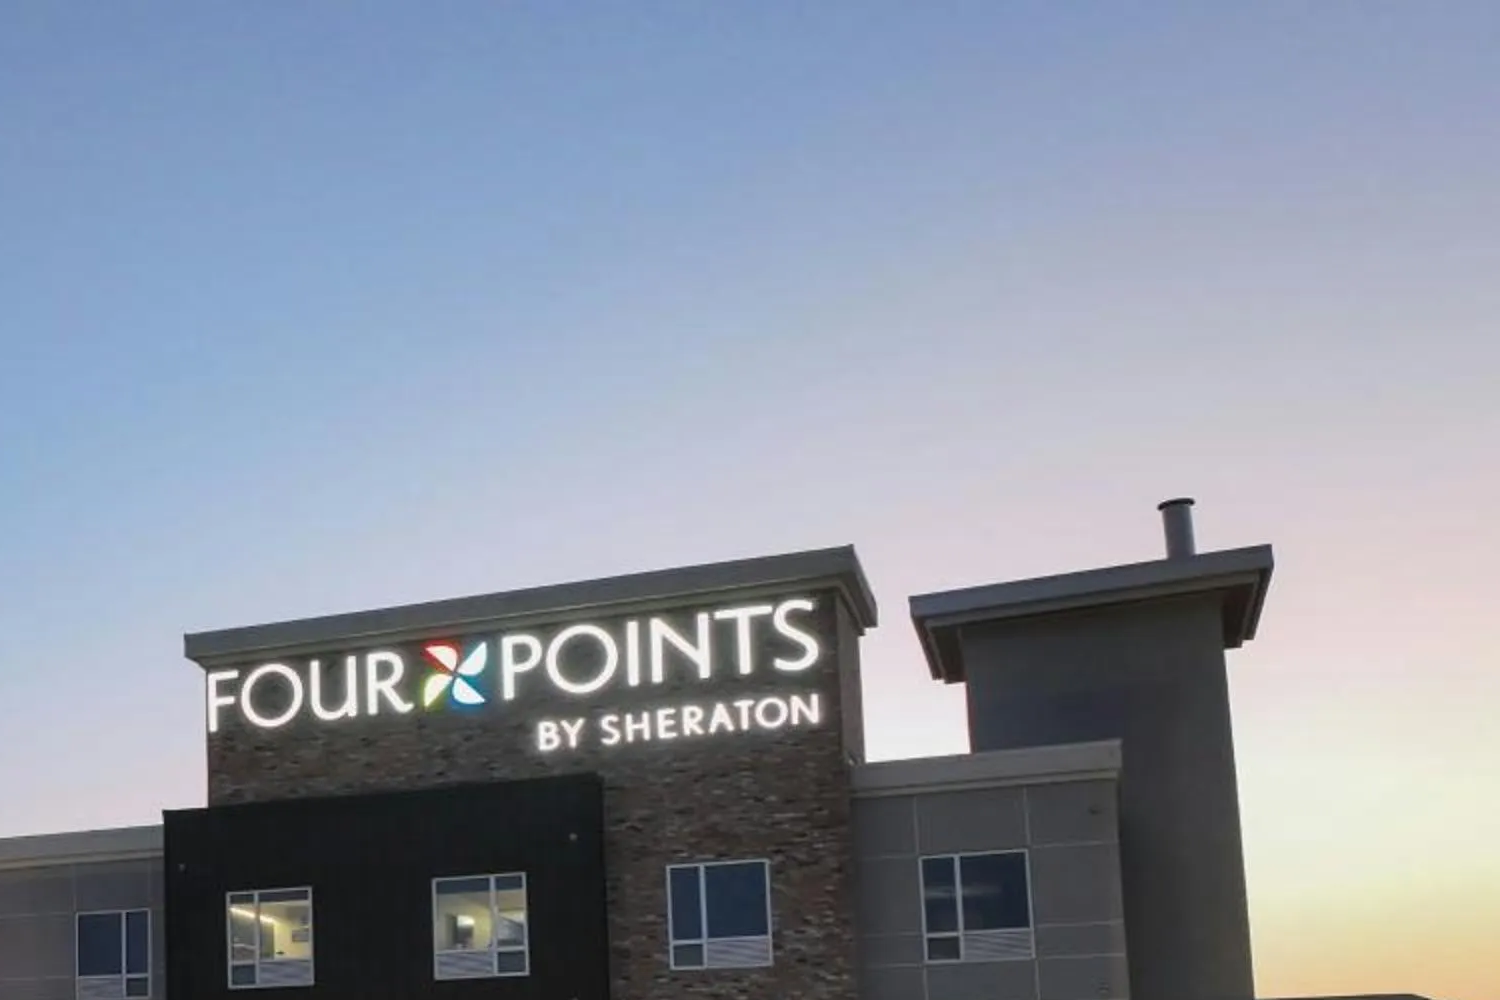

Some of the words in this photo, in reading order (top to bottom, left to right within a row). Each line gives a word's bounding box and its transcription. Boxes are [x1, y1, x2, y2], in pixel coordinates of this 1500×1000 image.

[207, 651, 414, 733] FOUR
[501, 599, 819, 701] POINTS
[536, 717, 585, 751] BY
[600, 693, 820, 745] SHERATON
